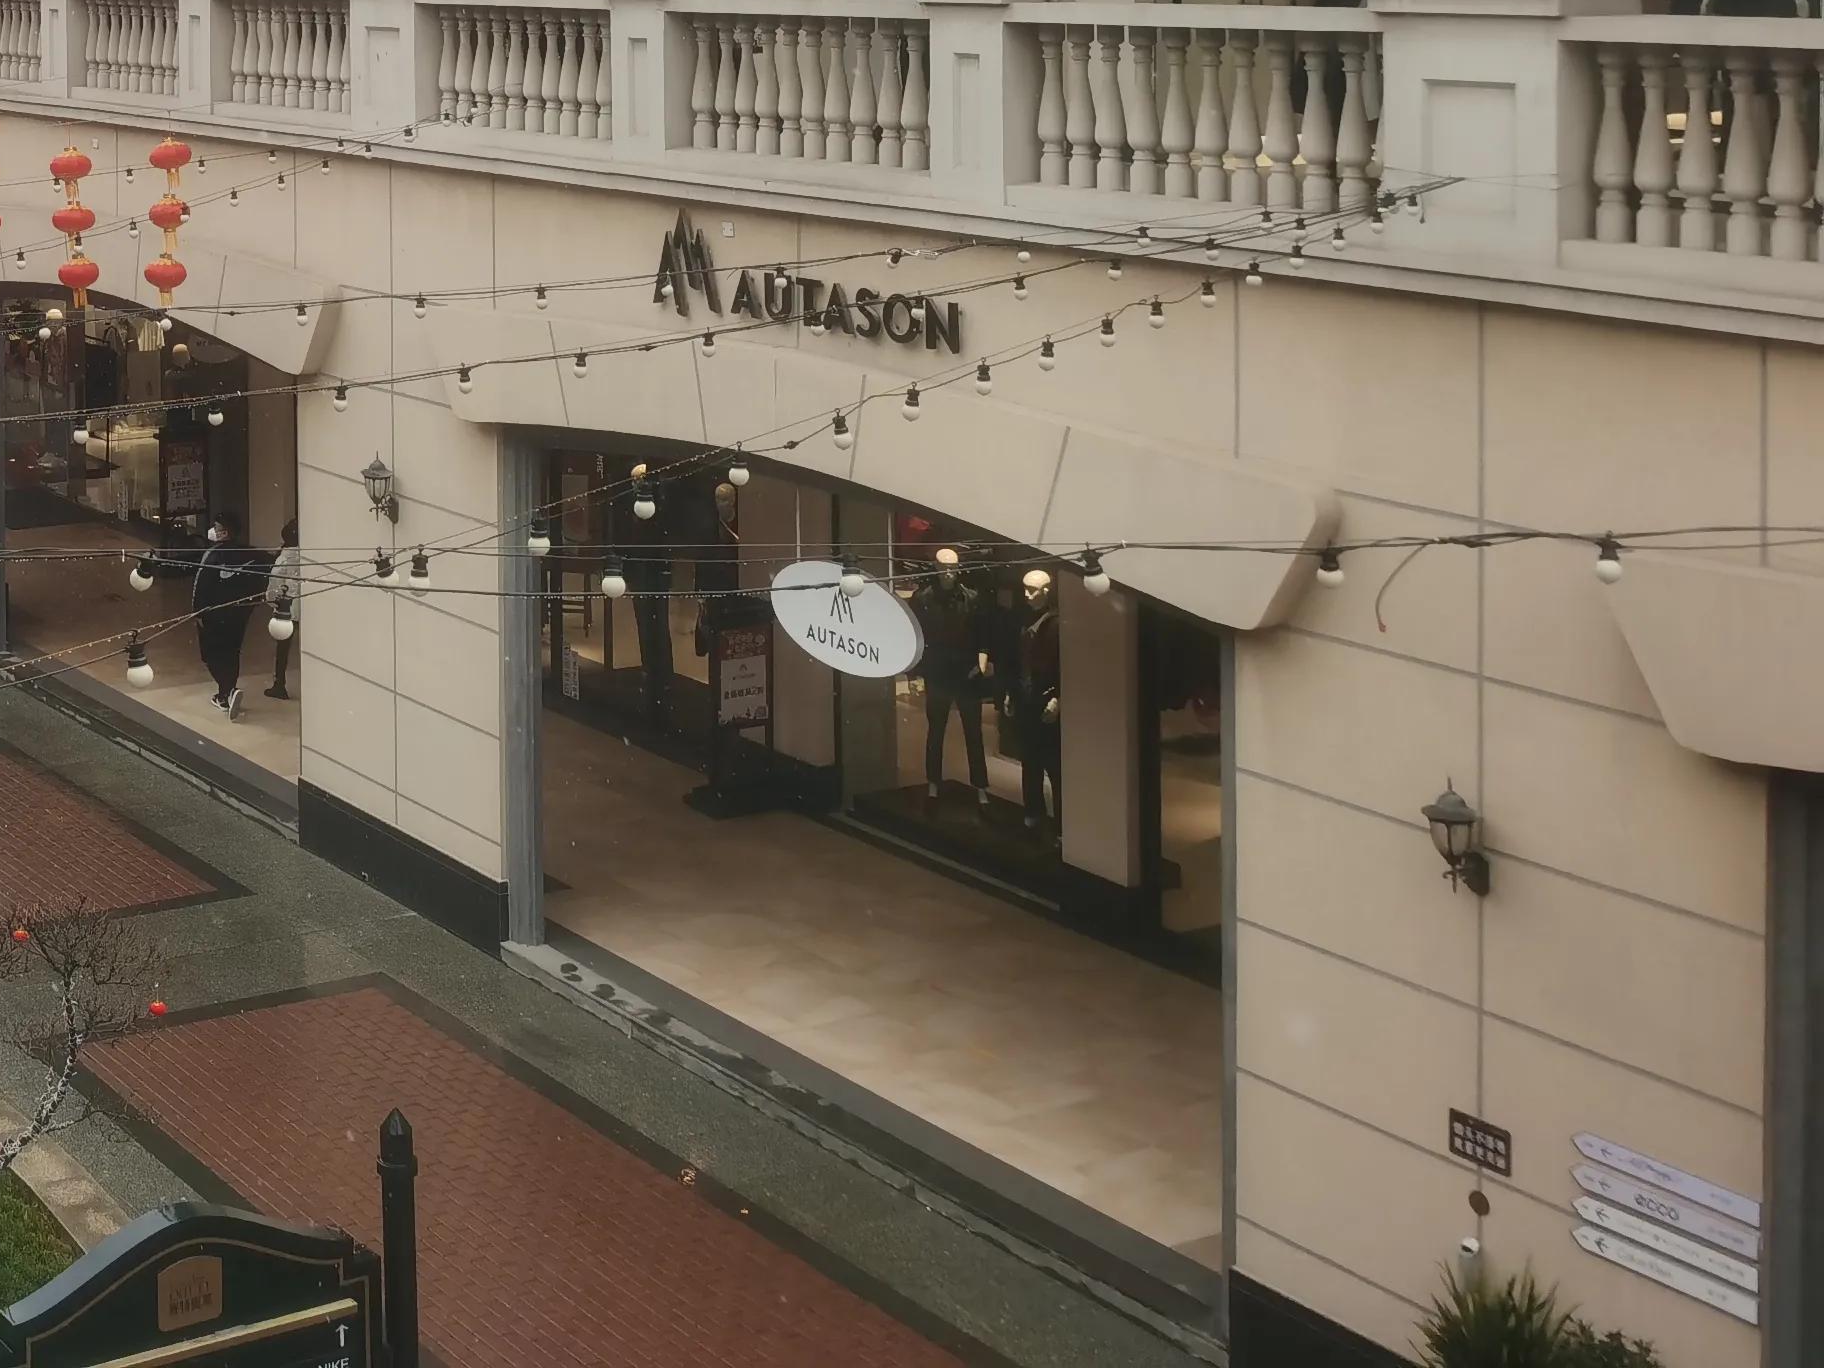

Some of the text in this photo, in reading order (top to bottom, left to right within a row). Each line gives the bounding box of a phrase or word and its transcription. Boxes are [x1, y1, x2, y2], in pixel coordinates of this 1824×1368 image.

[730, 269, 963, 355] AUTASON
[806, 624, 880, 664] AUTASON
[317, 1357, 350, 1368] KE
